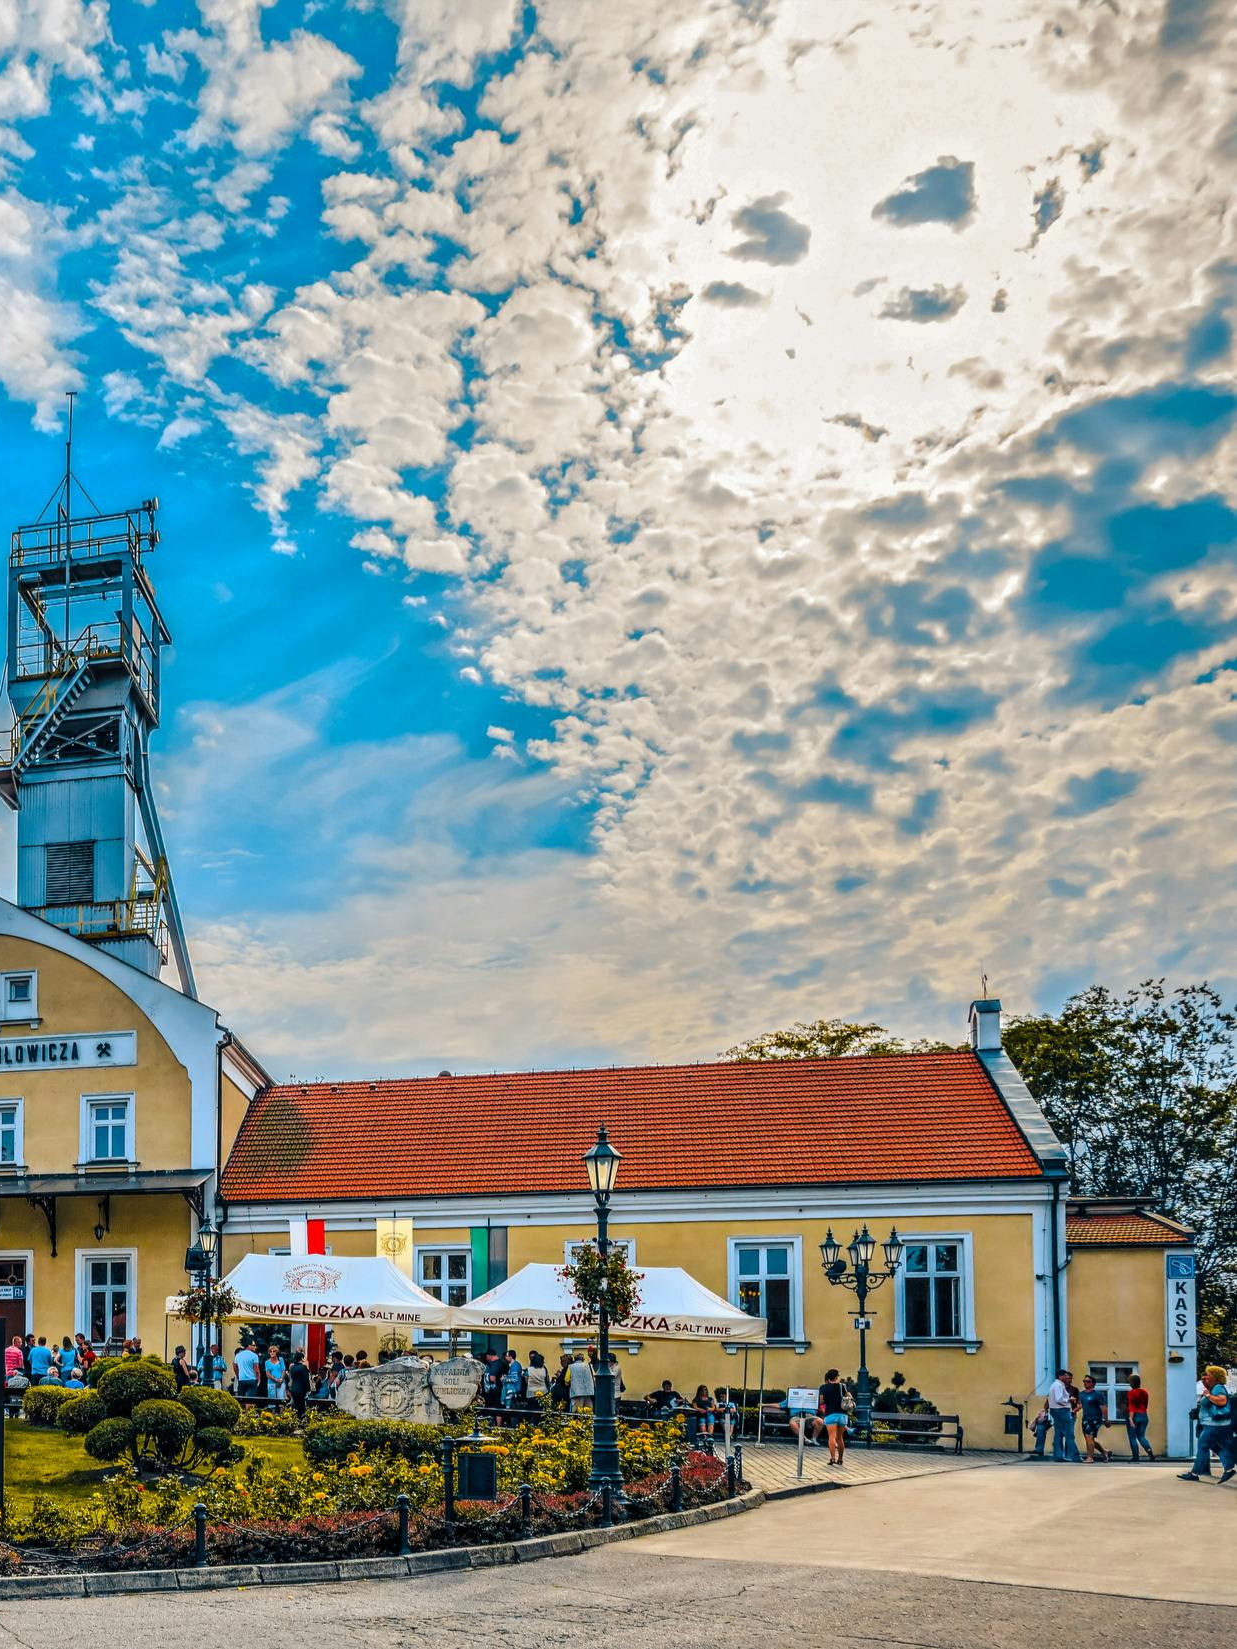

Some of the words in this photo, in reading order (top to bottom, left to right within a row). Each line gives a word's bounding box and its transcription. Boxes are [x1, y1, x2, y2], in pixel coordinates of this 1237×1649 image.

[245, 1304, 266, 1314] SOLI
[269, 1303, 365, 1318] WIELICZKA
[370, 1311, 394, 1320] SALT
[396, 1313, 421, 1322] MINE
[1175, 1282, 1188, 1342] KASY
[483, 1317, 534, 1326] KOPALNIA
[538, 1318, 561, 1326] SOLI
[675, 1323, 702, 1334] SALT
[704, 1326, 732, 1336] MINE
[434, 1368, 469, 1376] KOPALNIA
[443, 1378, 459, 1386] SOLI
